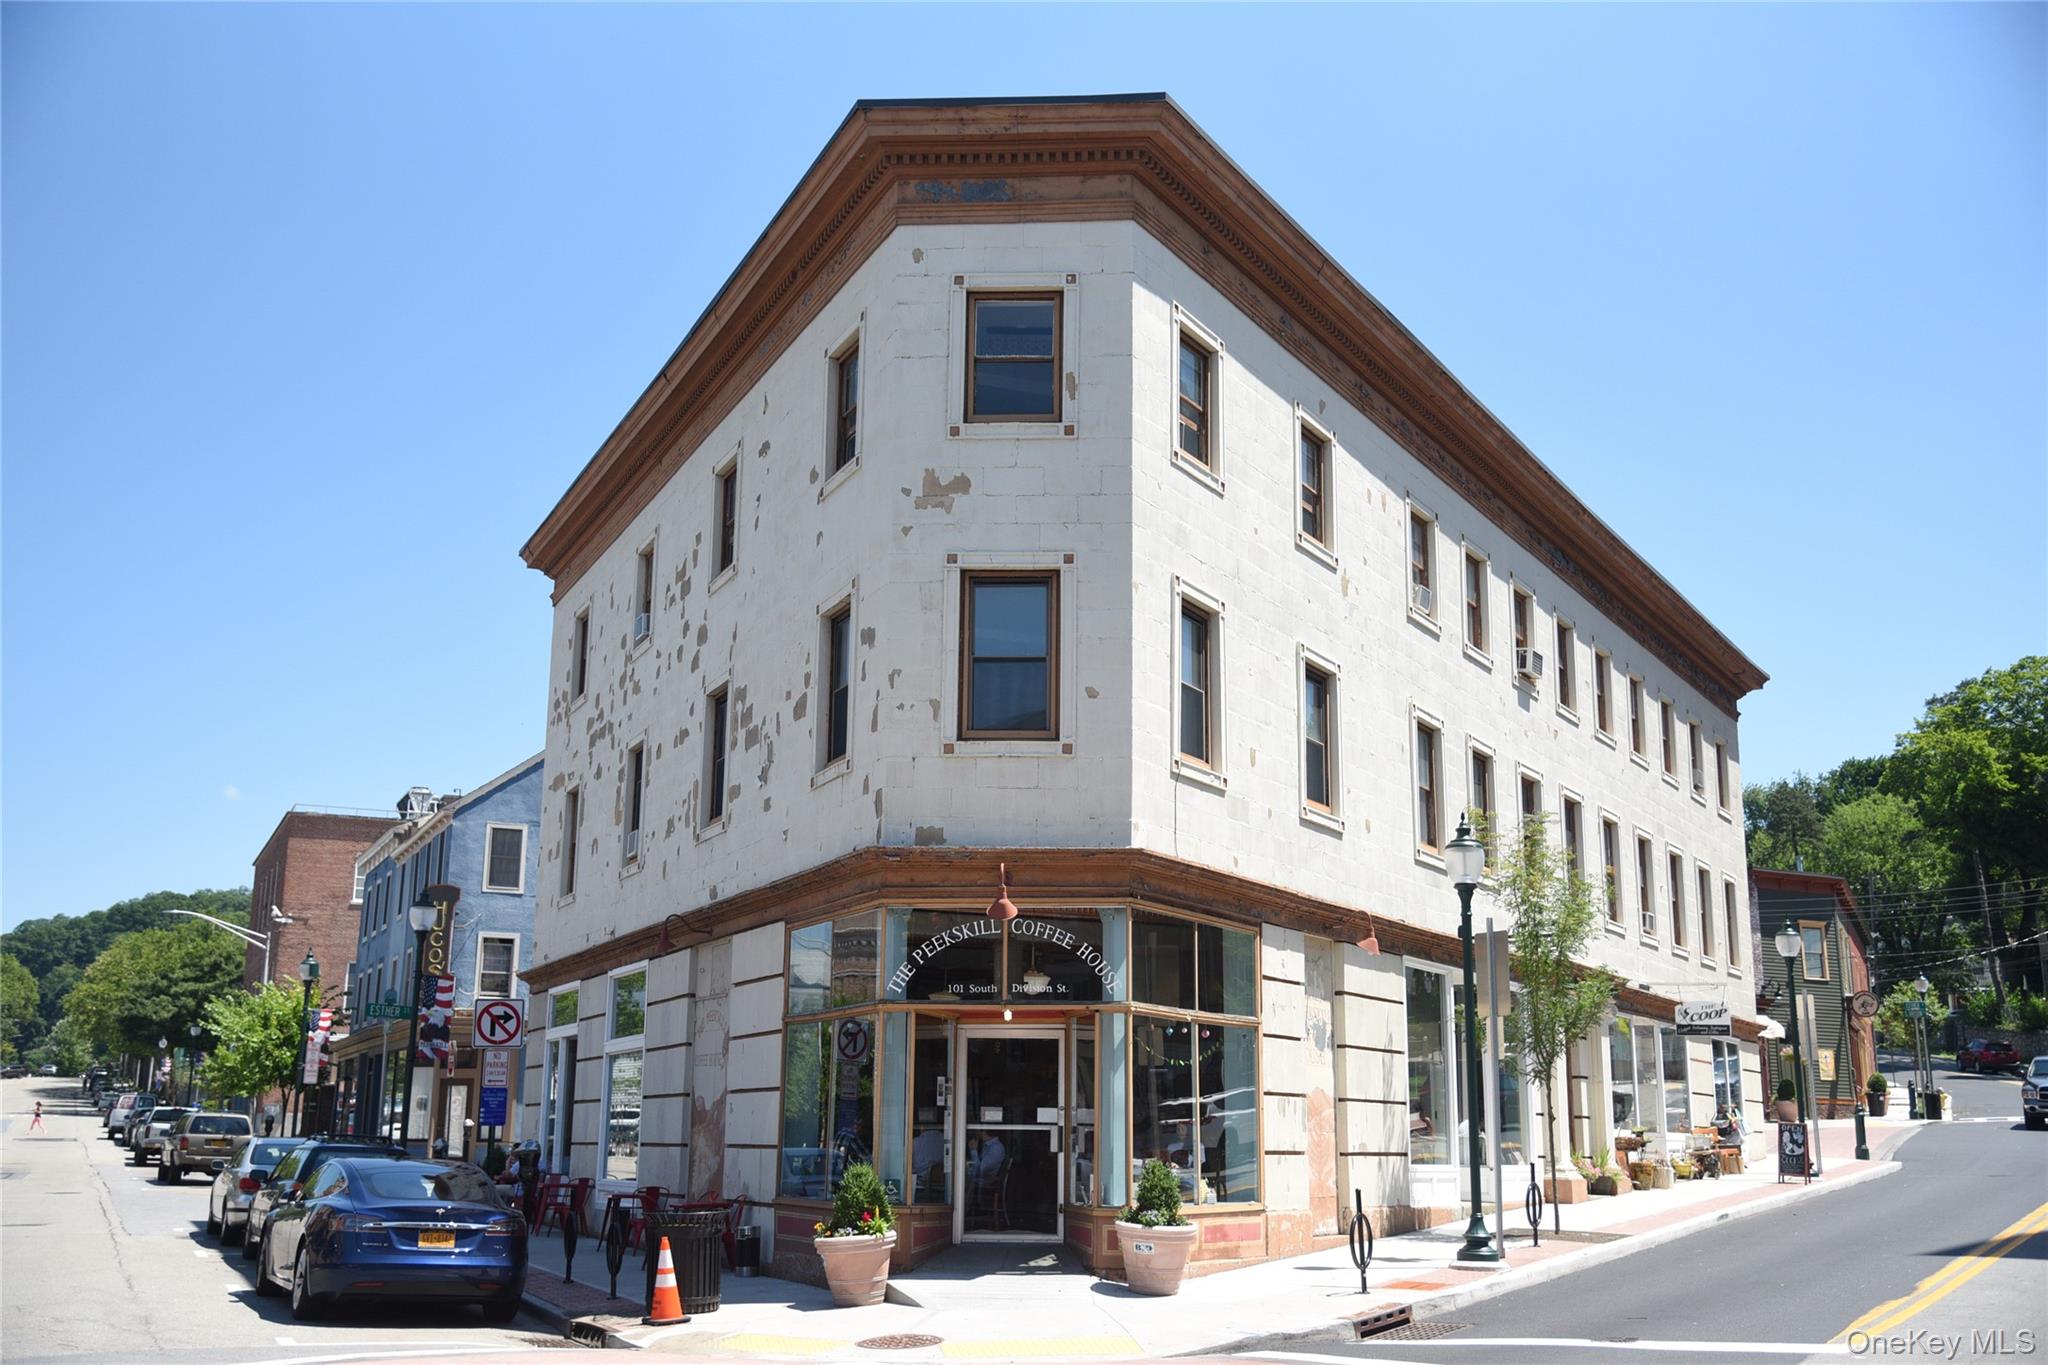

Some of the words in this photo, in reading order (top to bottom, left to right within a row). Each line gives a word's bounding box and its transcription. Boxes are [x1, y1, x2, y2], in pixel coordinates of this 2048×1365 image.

[887, 961, 916, 995] THE
[912, 920, 1001, 965] PEEKSKILL
[1012, 918, 1076, 950] COFFEE
[1076, 942, 1123, 995] HOUSE
[948, 984, 964, 993] 101
[969, 983, 998, 993] South
[1012, 983, 1053, 993] Division
[1057, 983, 1070, 993] St.
[370, 1004, 400, 1017] ESTHER
[493, 1052, 502, 1060] NO
